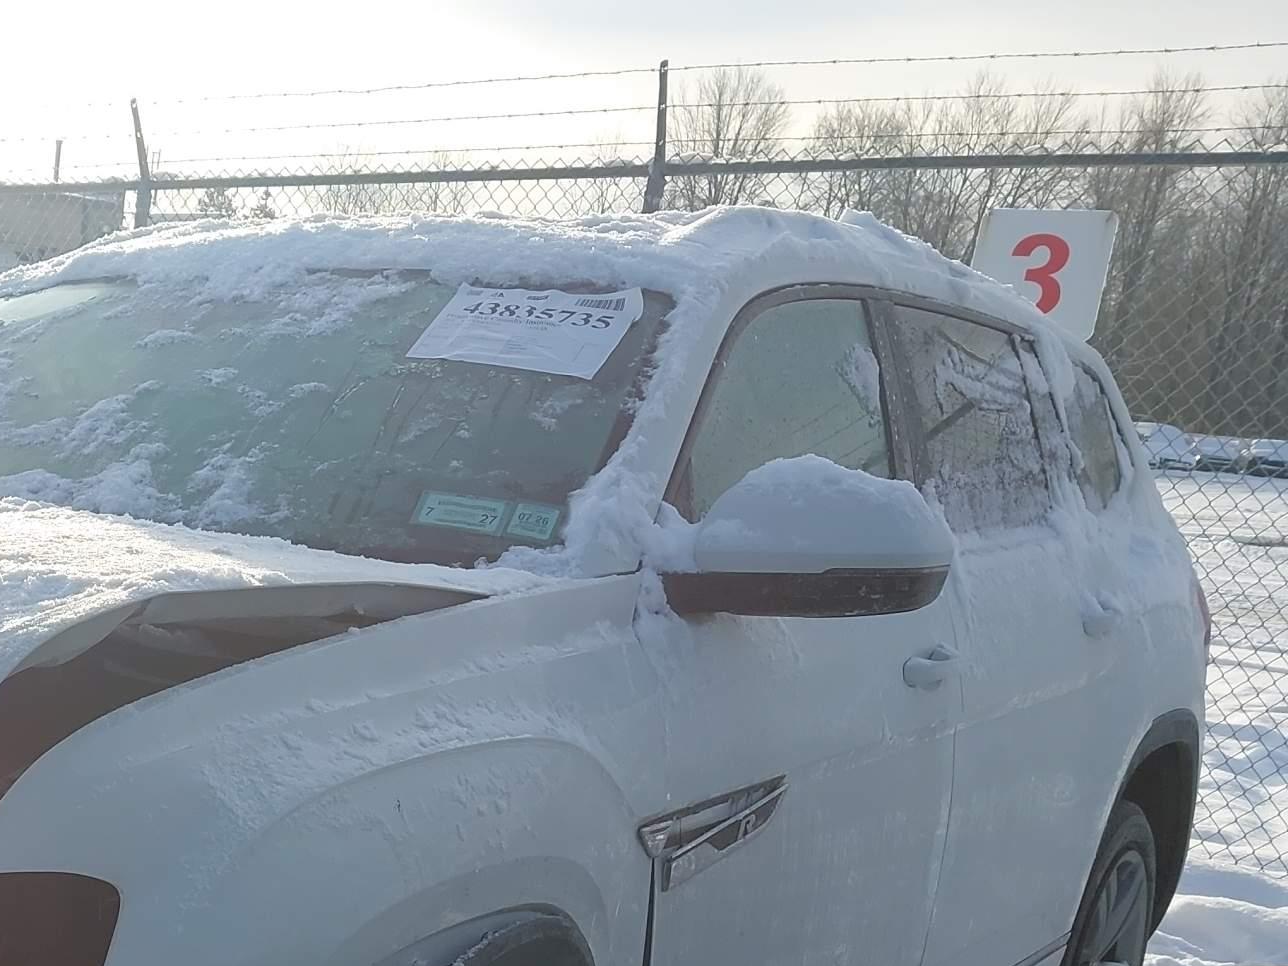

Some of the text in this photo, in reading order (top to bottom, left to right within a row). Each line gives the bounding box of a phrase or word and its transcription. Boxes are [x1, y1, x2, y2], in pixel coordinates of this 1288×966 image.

[1011, 232, 1071, 315] 3
[463, 301, 615, 329] 43835735
[479, 514, 497, 525] 27
